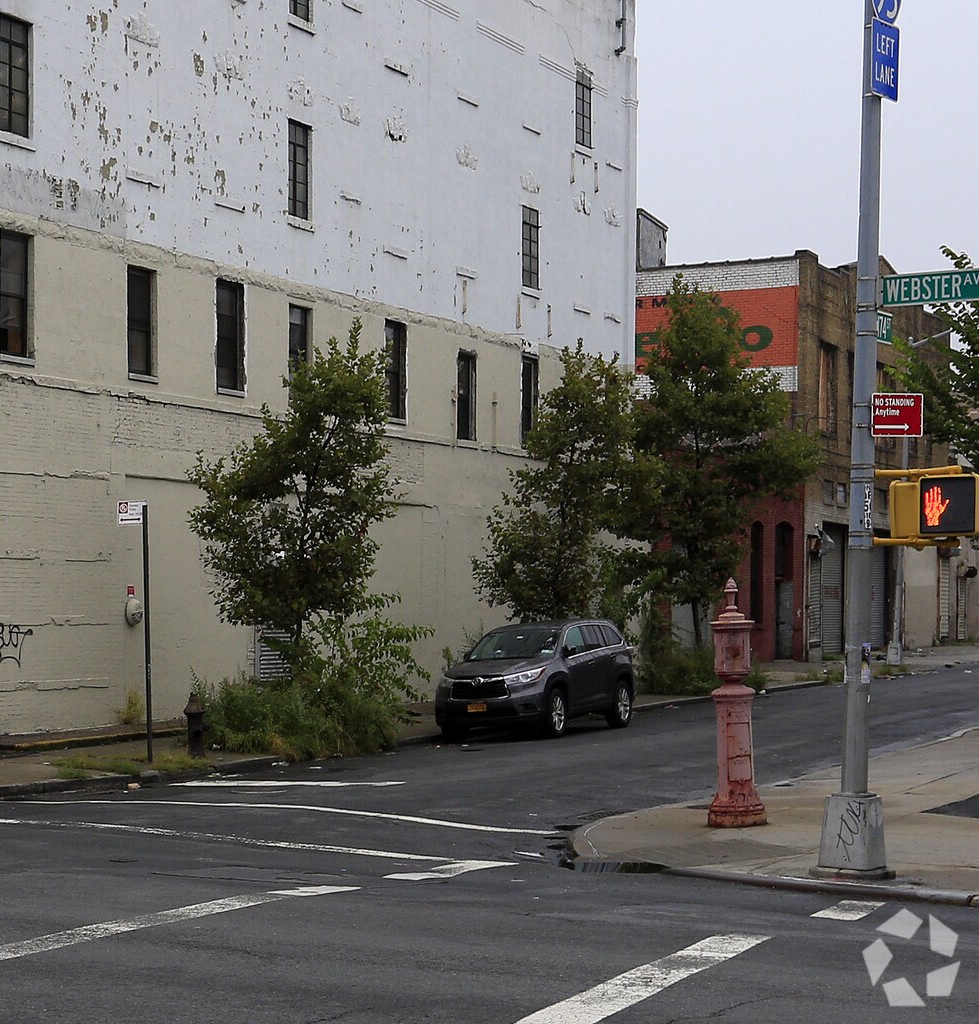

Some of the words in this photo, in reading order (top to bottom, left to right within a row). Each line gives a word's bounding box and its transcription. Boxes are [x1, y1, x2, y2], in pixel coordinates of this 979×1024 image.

[876, 32, 894, 58] LEFT
[875, 61, 894, 88] LANE
[886, 274, 962, 303] WEBSTER
[875, 398, 884, 406] NO
[885, 398, 915, 407] STANDING
[875, 407, 900, 418] Anytime
